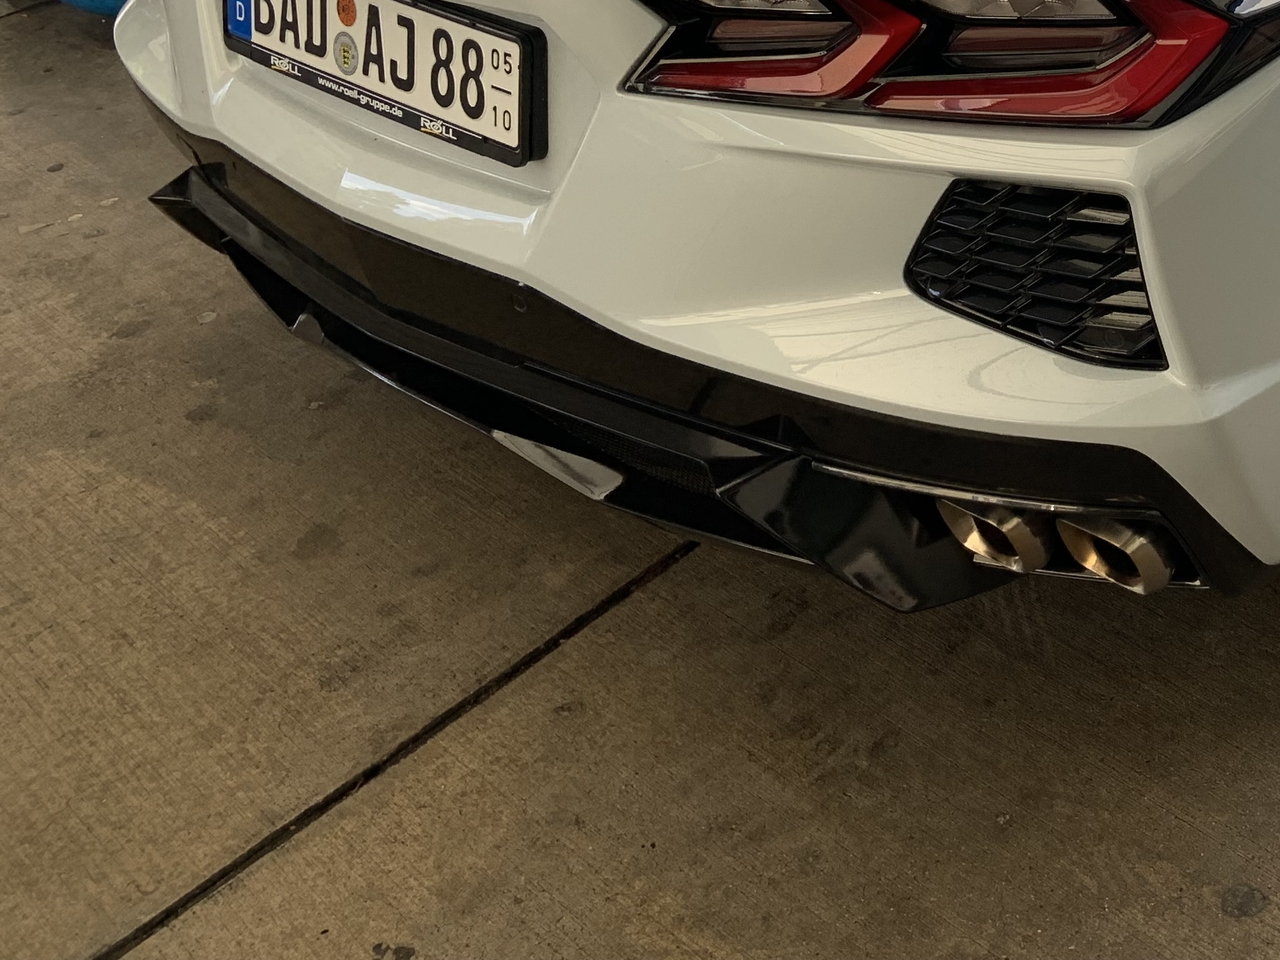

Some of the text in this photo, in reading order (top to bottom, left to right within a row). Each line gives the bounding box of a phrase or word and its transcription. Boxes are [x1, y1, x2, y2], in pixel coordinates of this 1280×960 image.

[236, 0, 245, 21] D
[362, 4, 415, 92] AJ
[430, 28, 484, 119] 88
[491, 48, 512, 74] 05
[493, 105, 511, 131] 10
